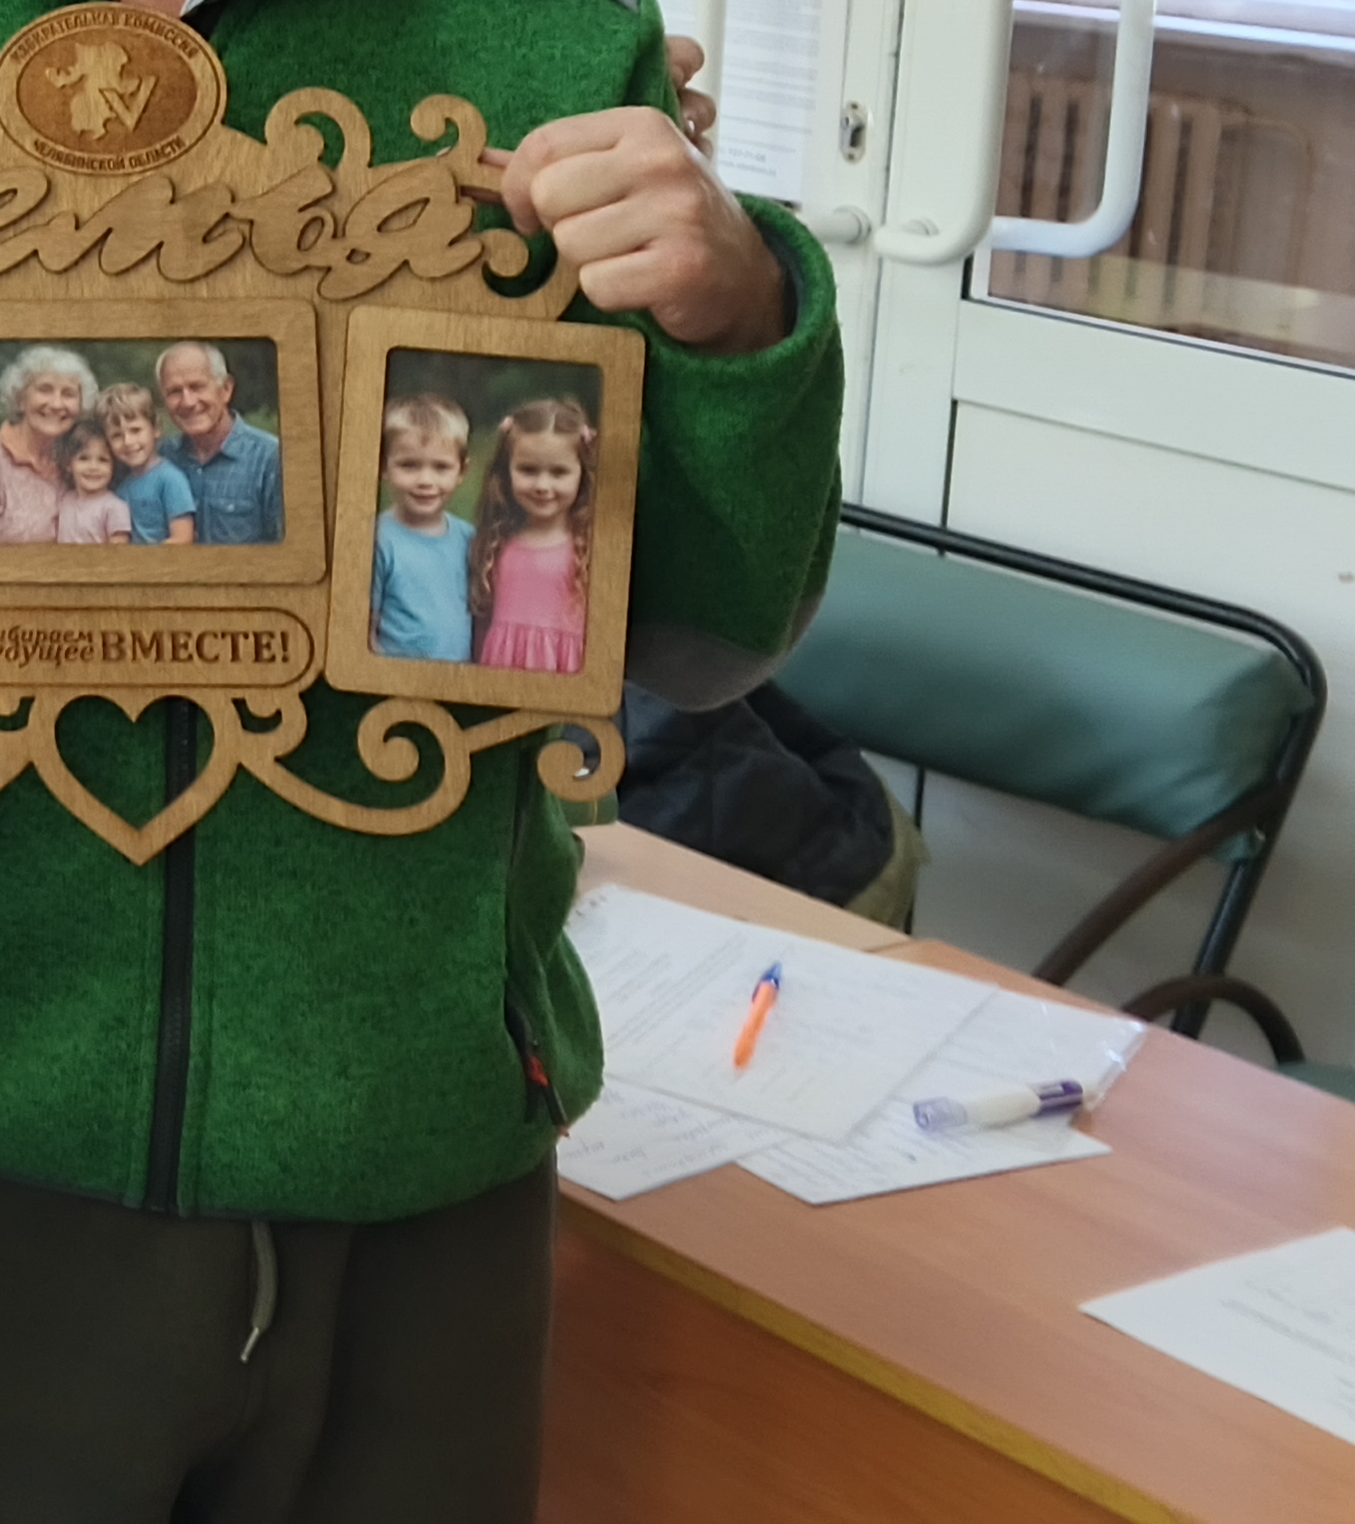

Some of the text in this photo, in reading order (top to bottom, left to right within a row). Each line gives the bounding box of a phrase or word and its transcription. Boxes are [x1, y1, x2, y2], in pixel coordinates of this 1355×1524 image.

[10, 11, 199, 64] ИЗБИРАТЕЛЬНАЯ КОМИССИЯ
[34, 136, 187, 170] ЧЕЛЯБИНСКОЙ ОБЛАСТИ
[100, 630, 290, 664] ВМЕСТЕ!
